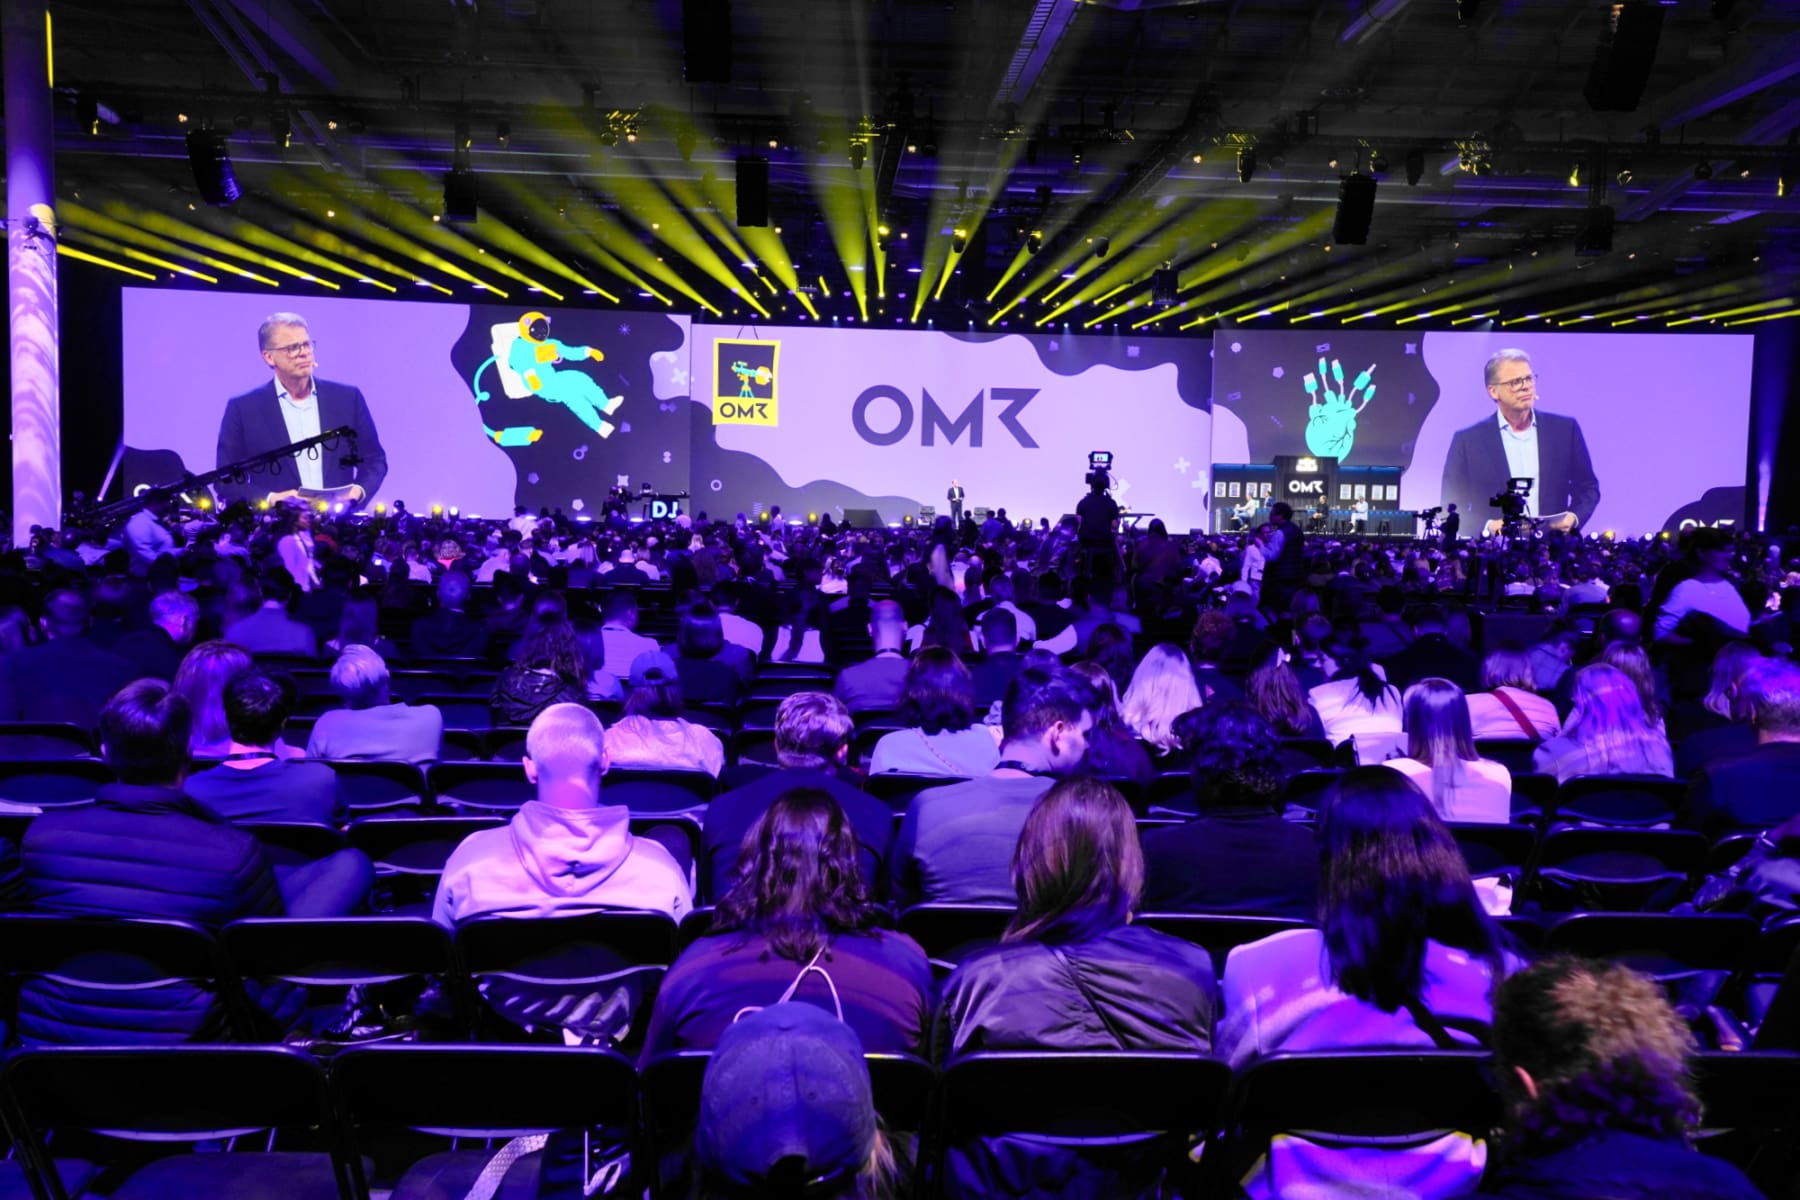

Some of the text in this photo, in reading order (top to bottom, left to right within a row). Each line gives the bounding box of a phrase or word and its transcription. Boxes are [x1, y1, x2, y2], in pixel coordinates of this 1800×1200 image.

[720, 402, 769, 419] OMR
[852, 384, 1041, 449] OMR
[1289, 480, 1324, 493] OMR
[652, 501, 679, 518] DJ
